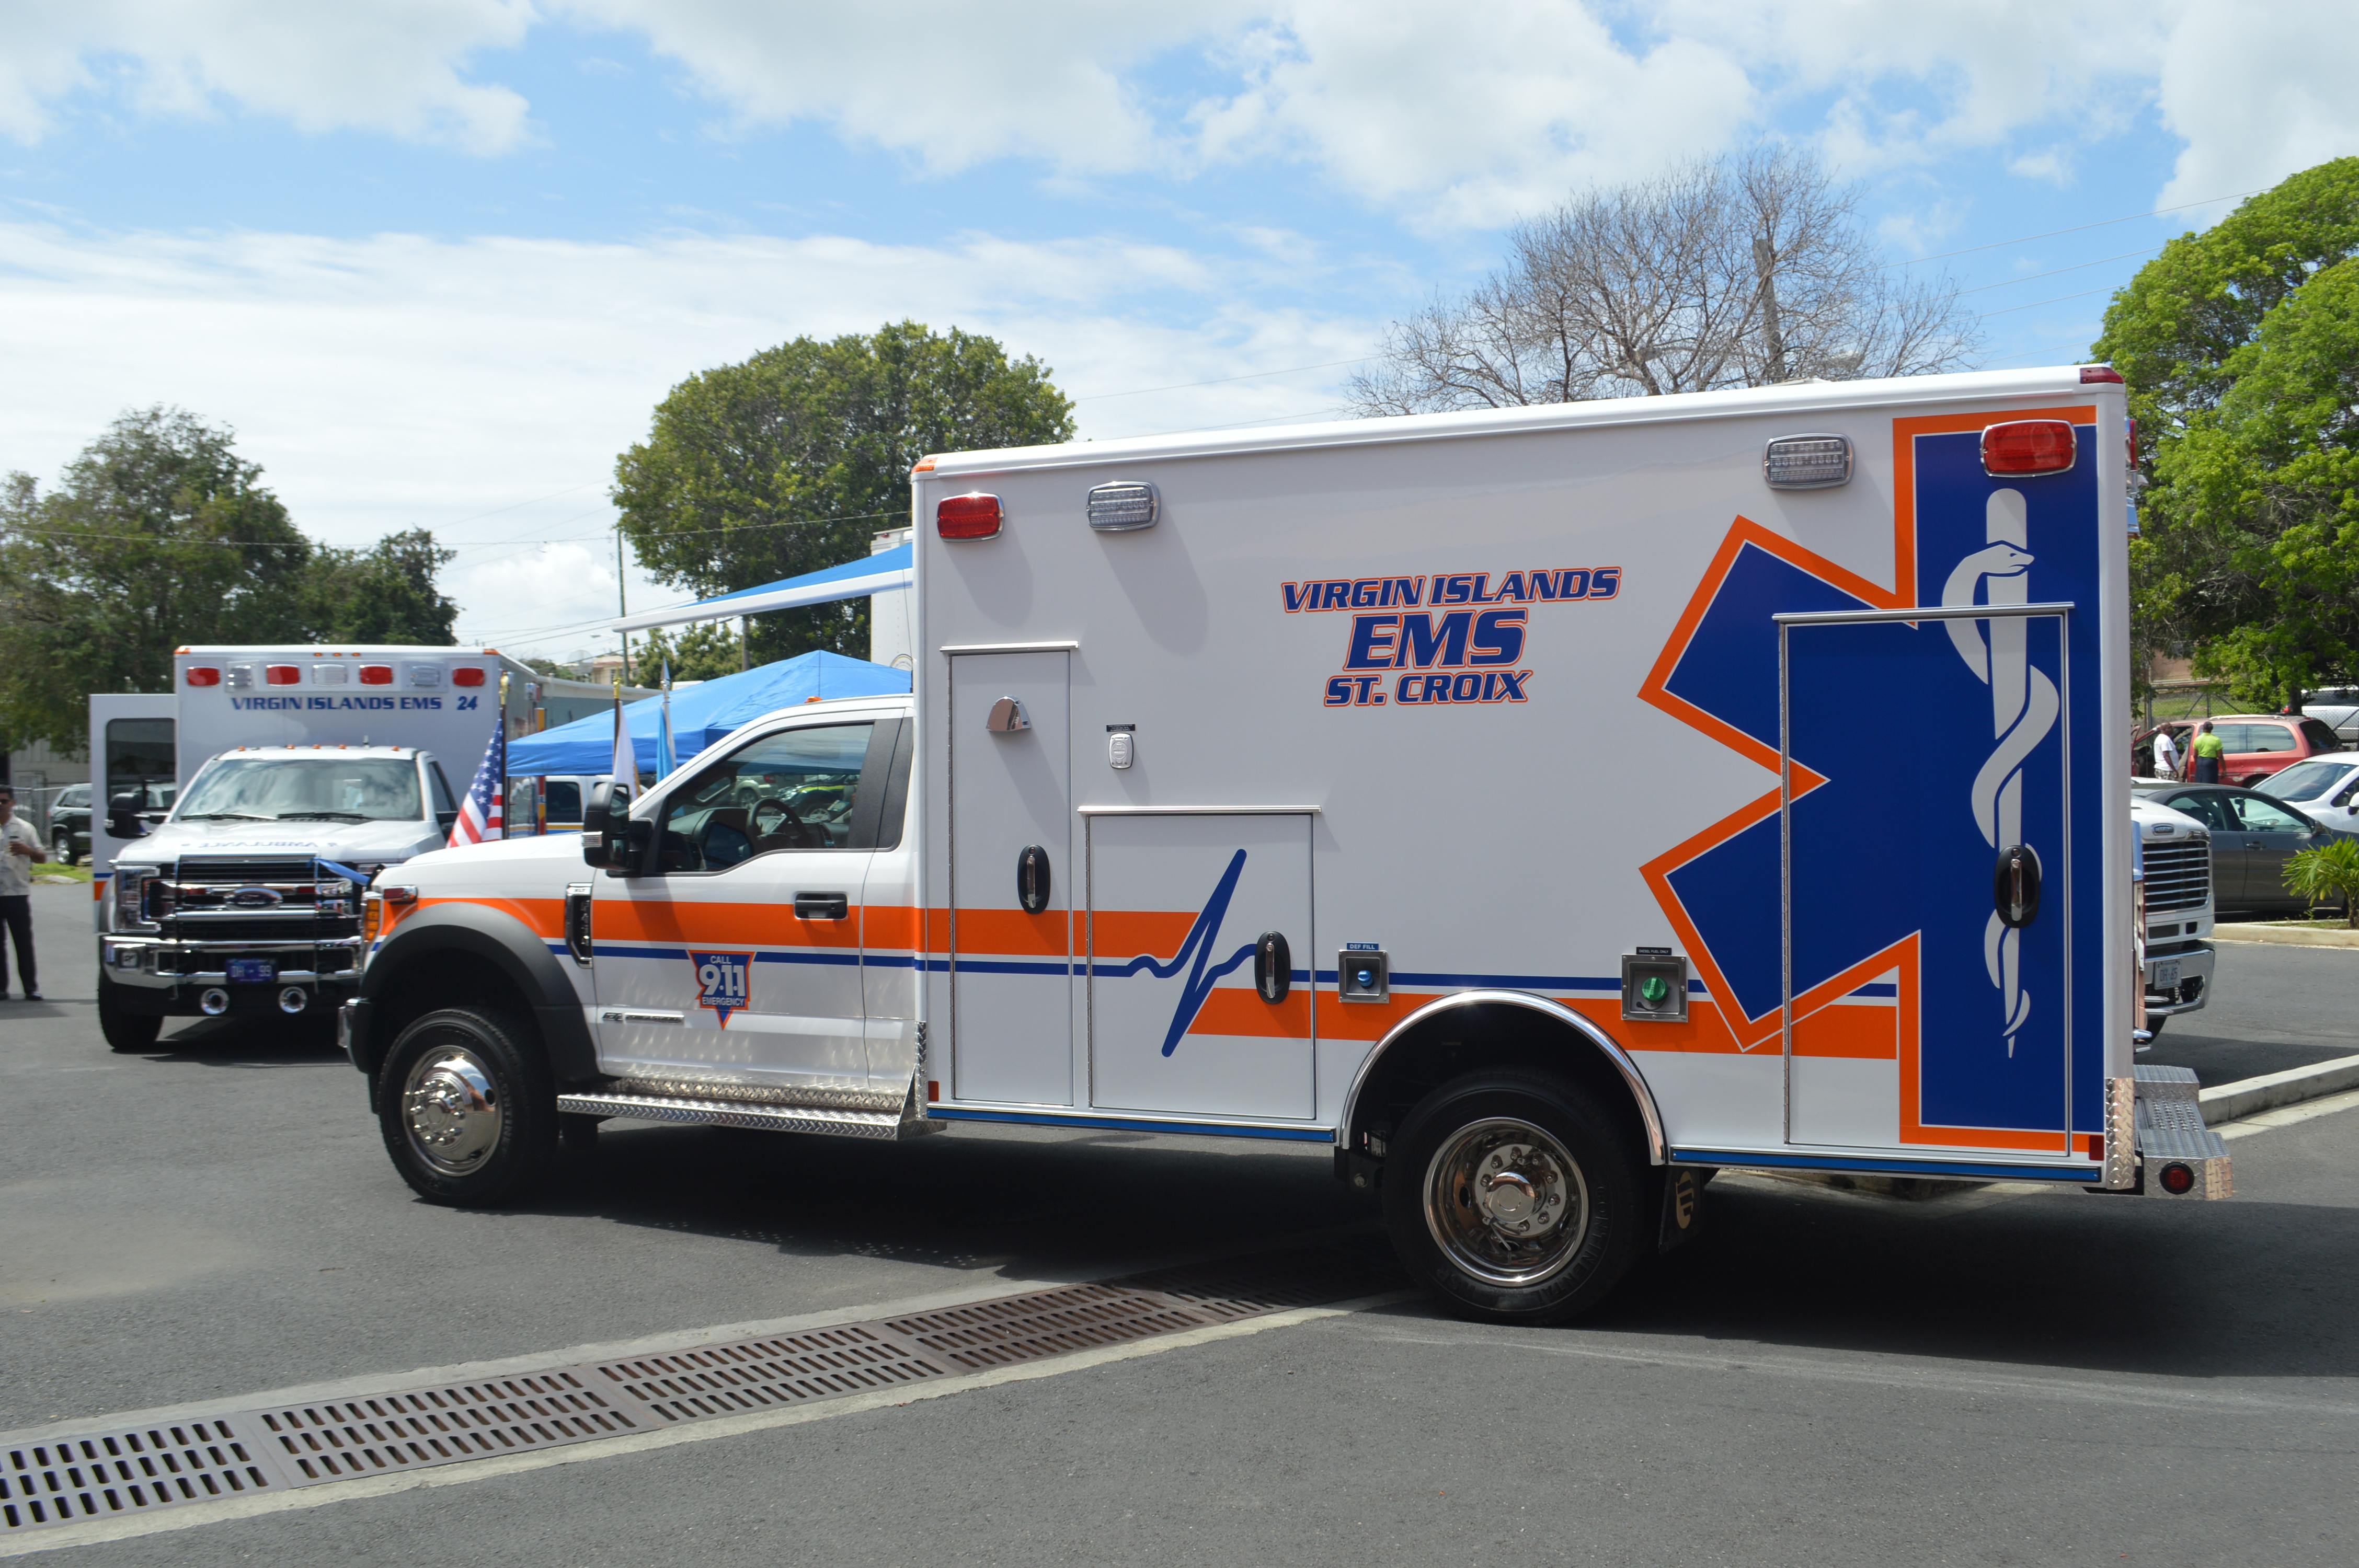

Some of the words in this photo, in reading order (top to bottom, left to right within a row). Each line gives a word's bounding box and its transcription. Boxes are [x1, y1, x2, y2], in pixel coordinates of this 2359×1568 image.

[1281, 575, 1426, 613] VIRGIN
[1427, 566, 1621, 607] ISLANDS
[1343, 607, 1528, 671] EMS
[1324, 674, 1387, 707] ST.
[1395, 670, 1533, 705] CROIX
[231, 697, 302, 710] VIRGIN
[307, 697, 394, 710] ISLANDS
[400, 697, 442, 710] EMS
[456, 696, 478, 710] 24
[710, 955, 732, 964] CALL
[702, 997, 744, 1006] EMERGENCY
[1530, 1186, 1609, 1305] CONTINENTAL
